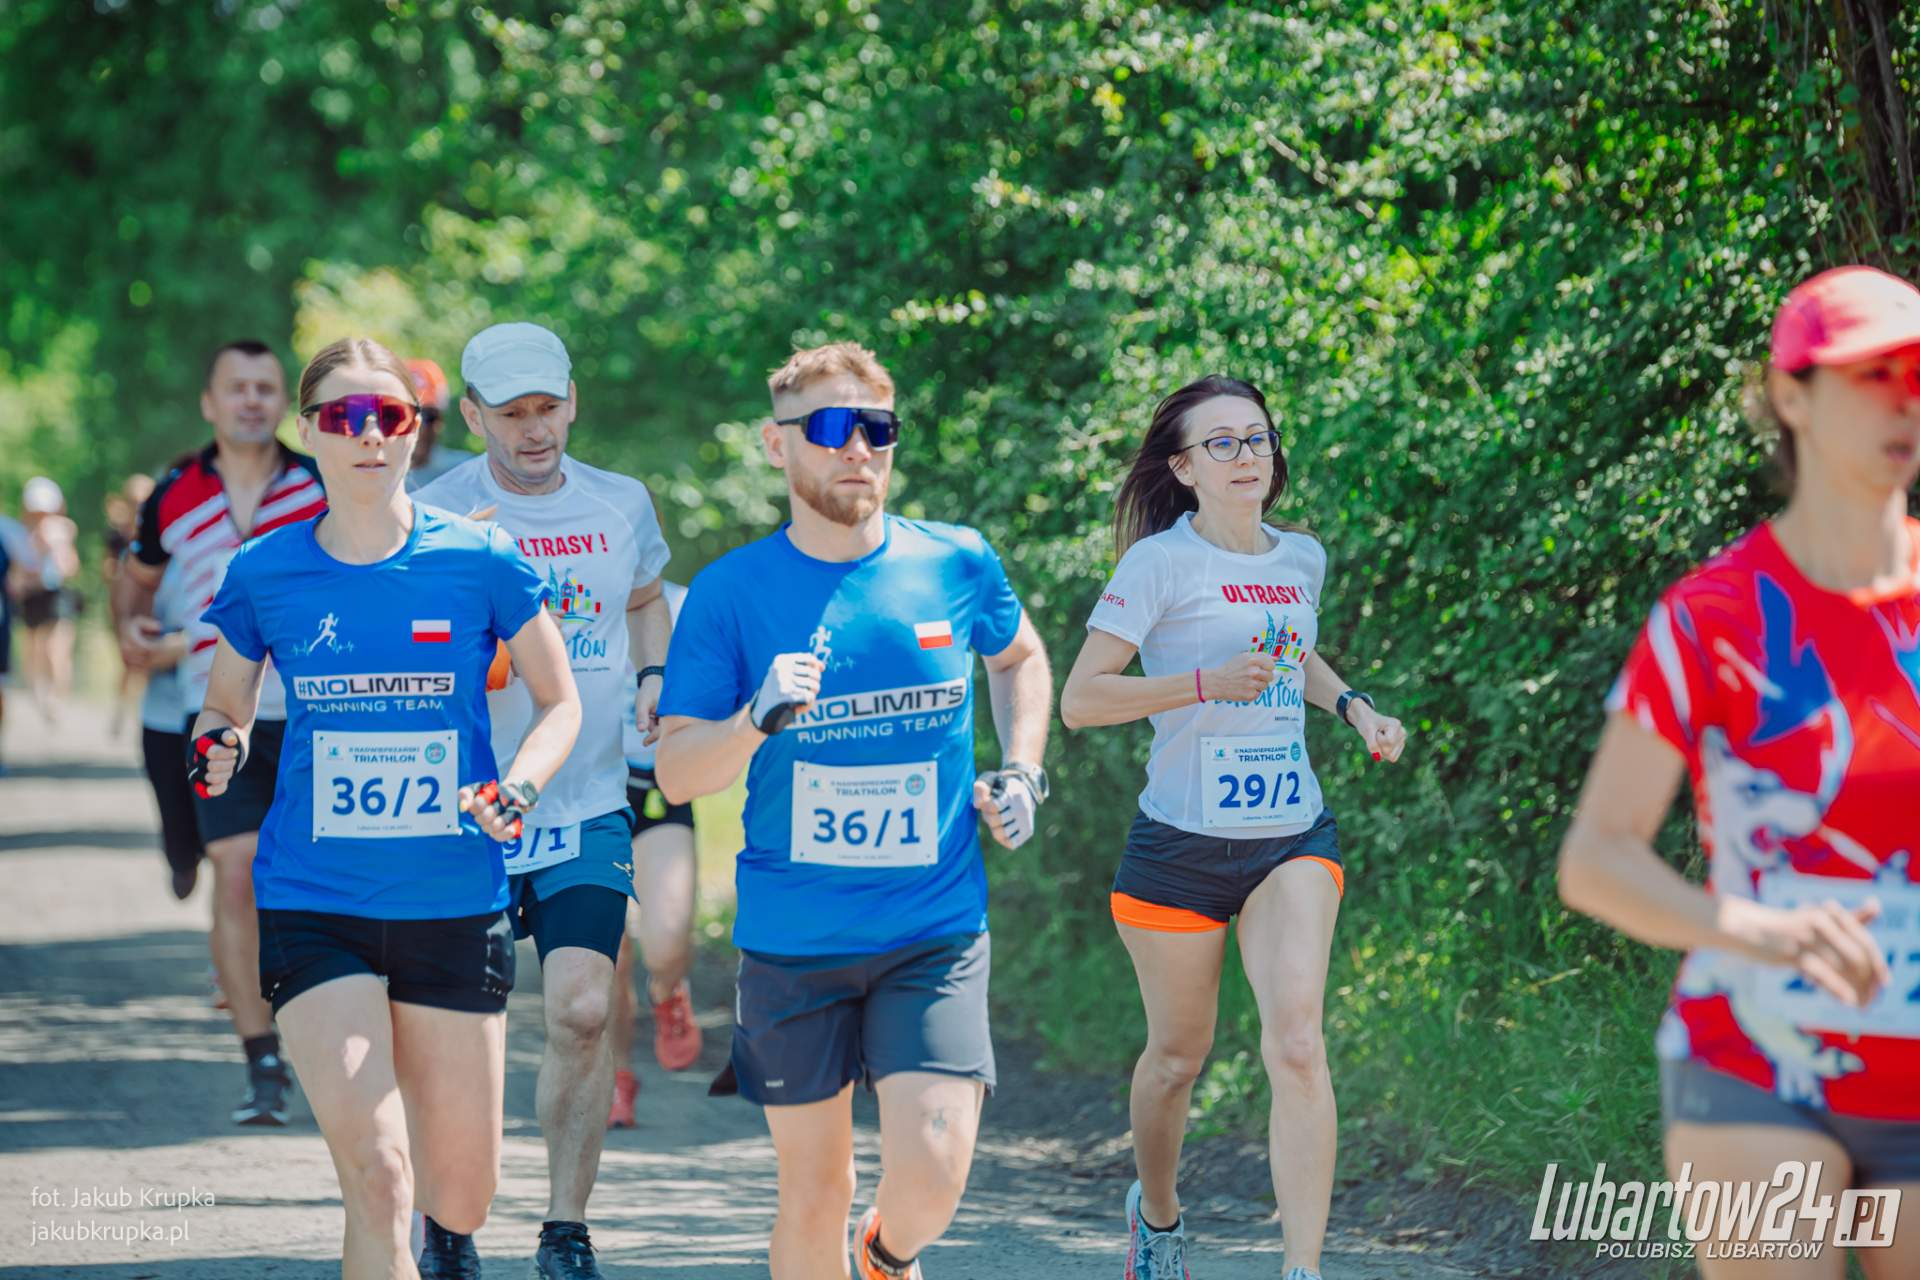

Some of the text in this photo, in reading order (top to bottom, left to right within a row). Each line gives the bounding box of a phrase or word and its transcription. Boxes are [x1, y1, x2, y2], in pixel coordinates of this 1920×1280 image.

[518, 533, 593, 557] LTRASY
[393, 699, 444, 711] TEAM
[797, 685, 964, 724] NOLIMITS
[797, 712, 955, 744] RUNNING TEAM
[353, 754, 416, 763] TRIATHLON
[1239, 753, 1286, 762] TRIATHLON
[331, 776, 442, 818] 36/2
[1218, 771, 1301, 809] 29/2
[501, 827, 566, 860] 9/1
[813, 808, 921, 848] 36/1
